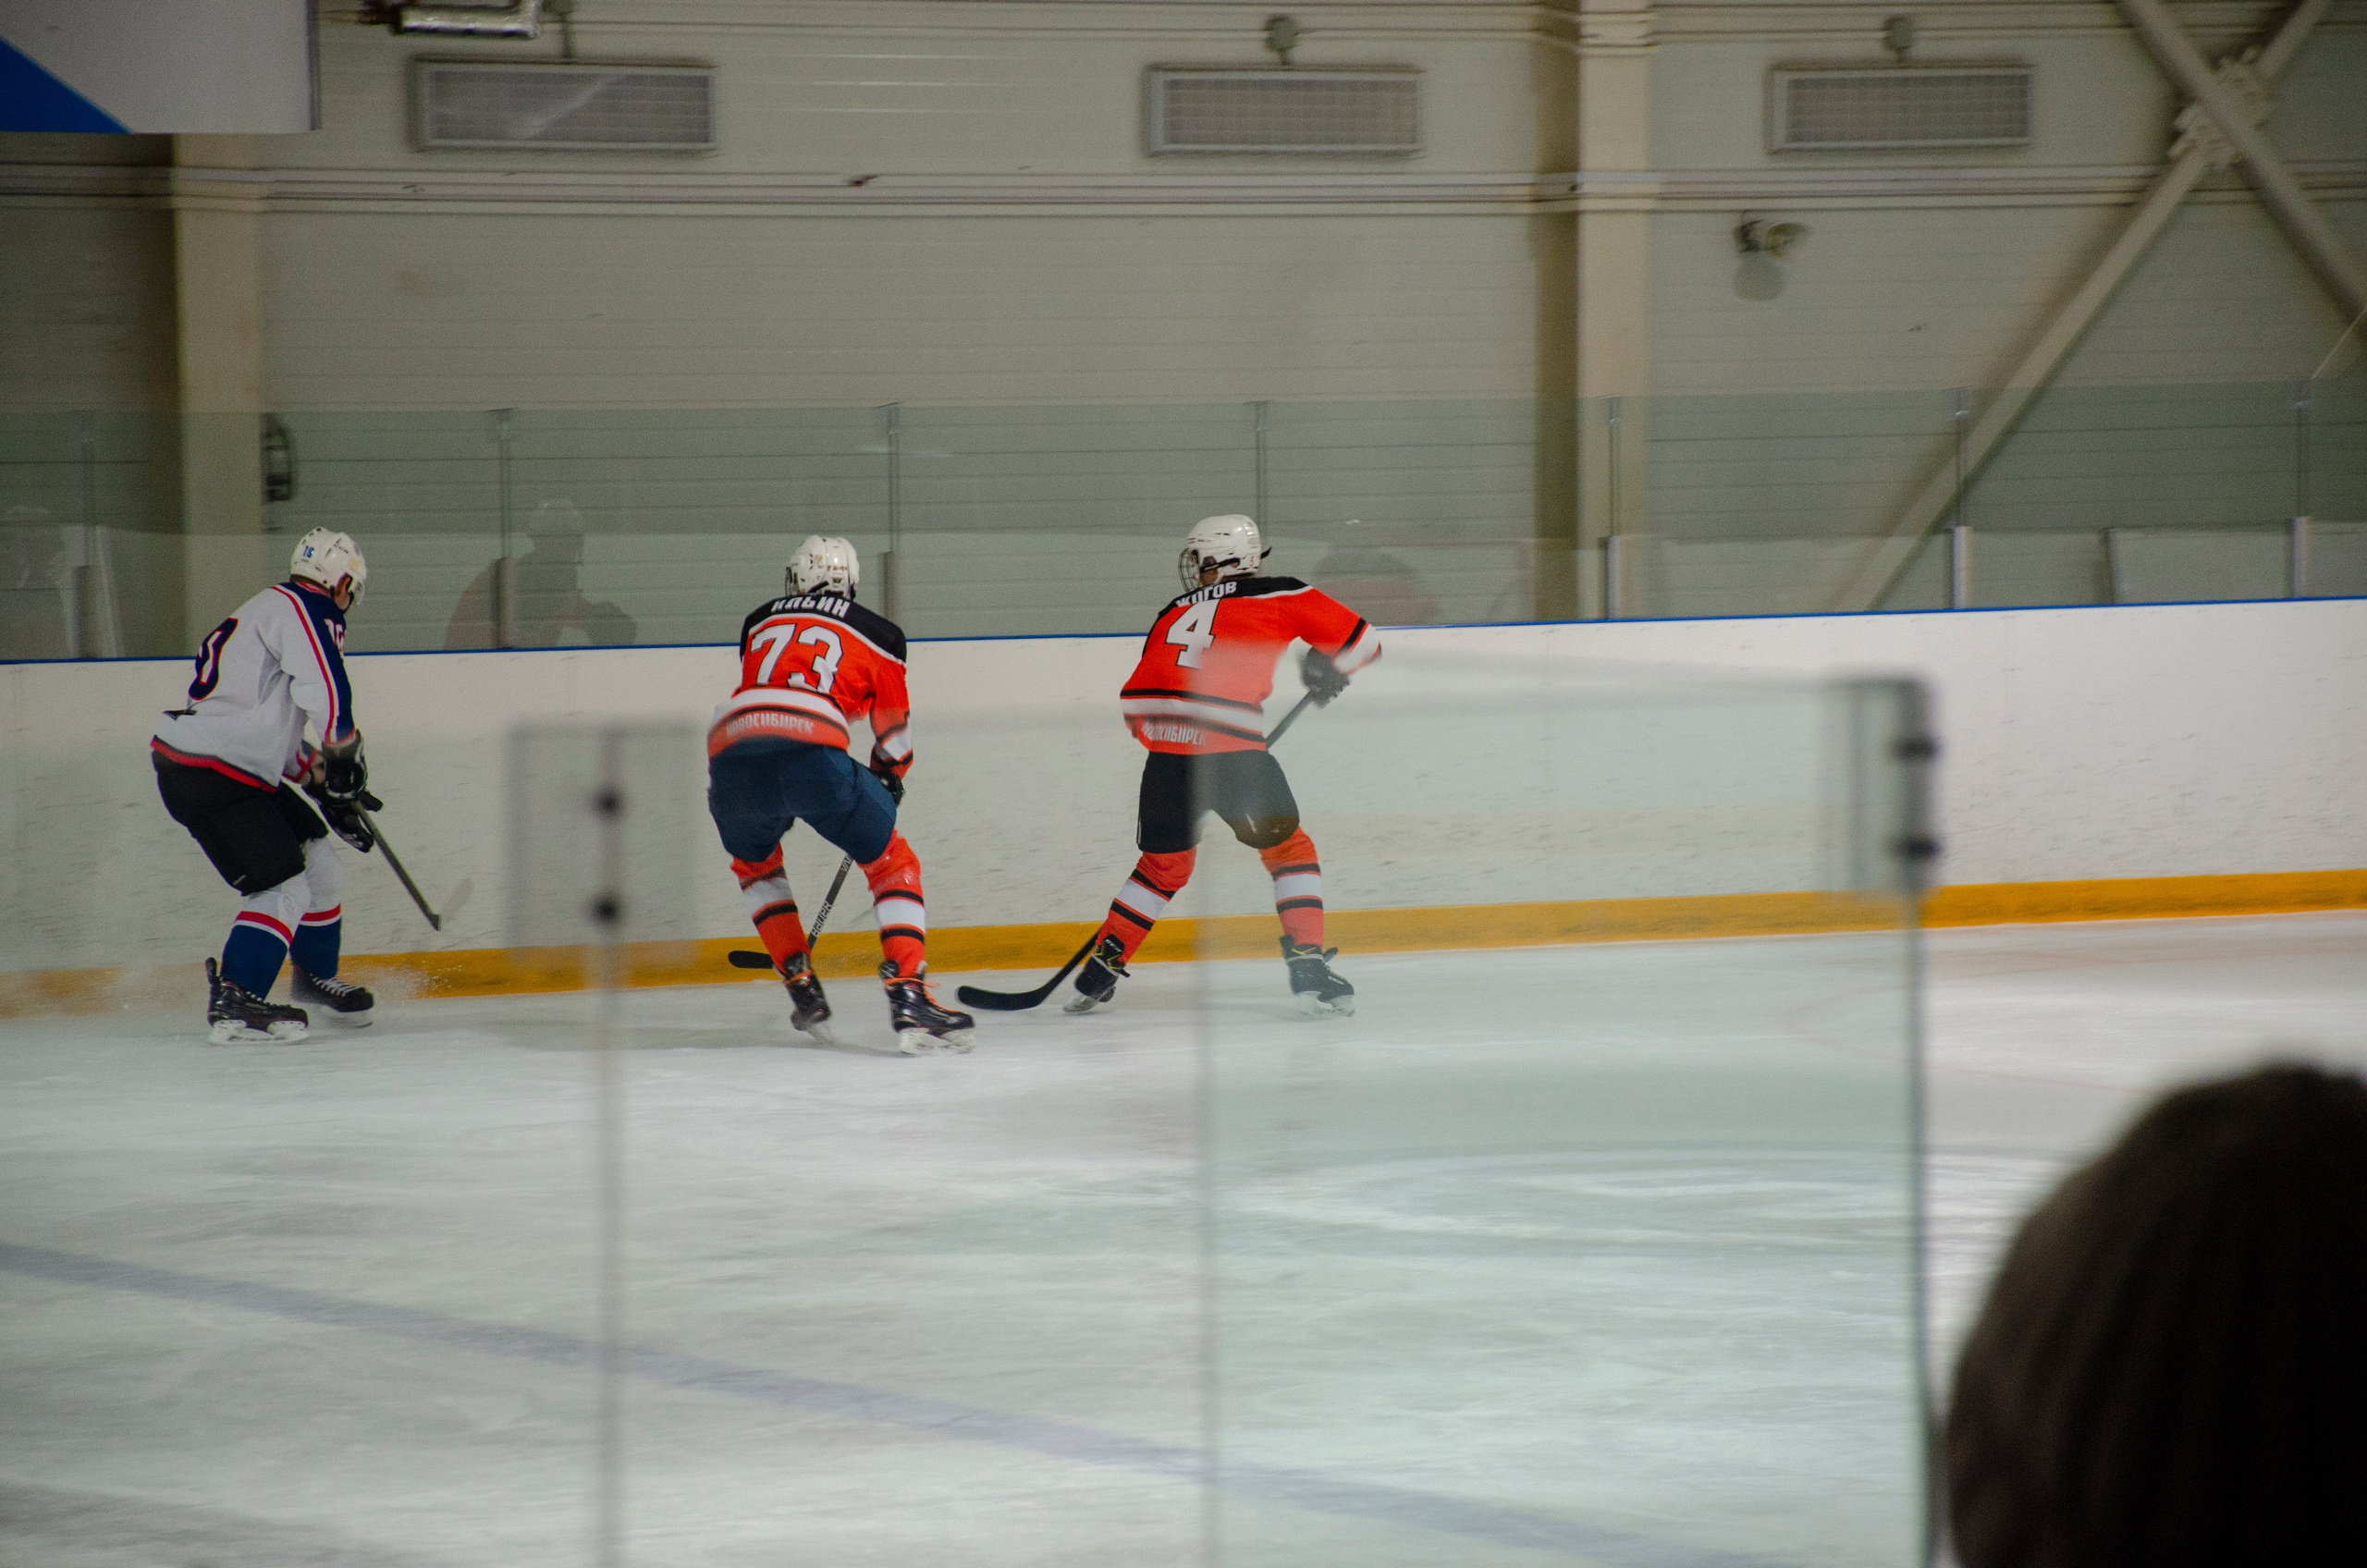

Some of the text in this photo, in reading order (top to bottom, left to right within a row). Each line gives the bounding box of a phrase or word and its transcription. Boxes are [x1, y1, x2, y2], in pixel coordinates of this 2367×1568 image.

[771, 596, 851, 619] ИЛЬИН
[1165, 598, 1220, 669] 4
[750, 622, 843, 694] 73
[811, 900, 832, 937] BAUER
